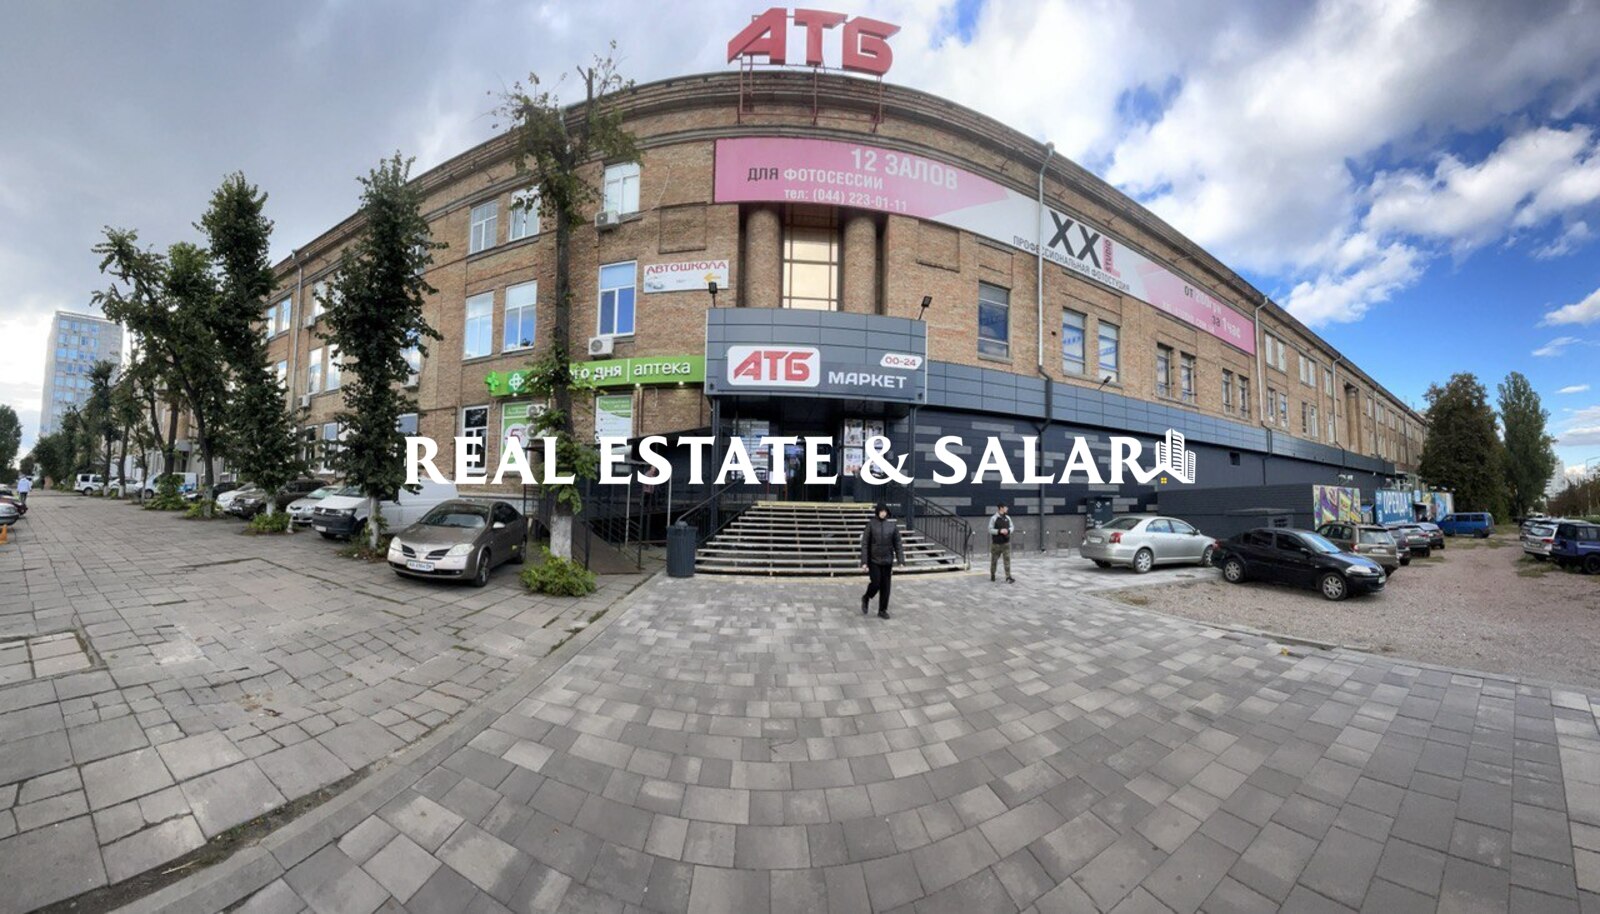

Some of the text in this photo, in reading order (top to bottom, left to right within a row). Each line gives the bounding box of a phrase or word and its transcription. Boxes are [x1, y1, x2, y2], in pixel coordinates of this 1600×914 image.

[728, 7, 901, 76] АТБ
[747, 168, 884, 190] ДЛЯ ФОТОСЕССИИ
[851, 148, 958, 190] 12 ЗАЛОВ
[784, 188, 907, 211] тел: (044) 223-01-11
[646, 261, 727, 275] АВТОШКОЛА
[593, 364, 622, 380] дня
[634, 361, 691, 376] аптека
[733, 350, 815, 382] АТБ
[884, 356, 917, 368] 00-24
[828, 371, 907, 389] МАРКЕТ
